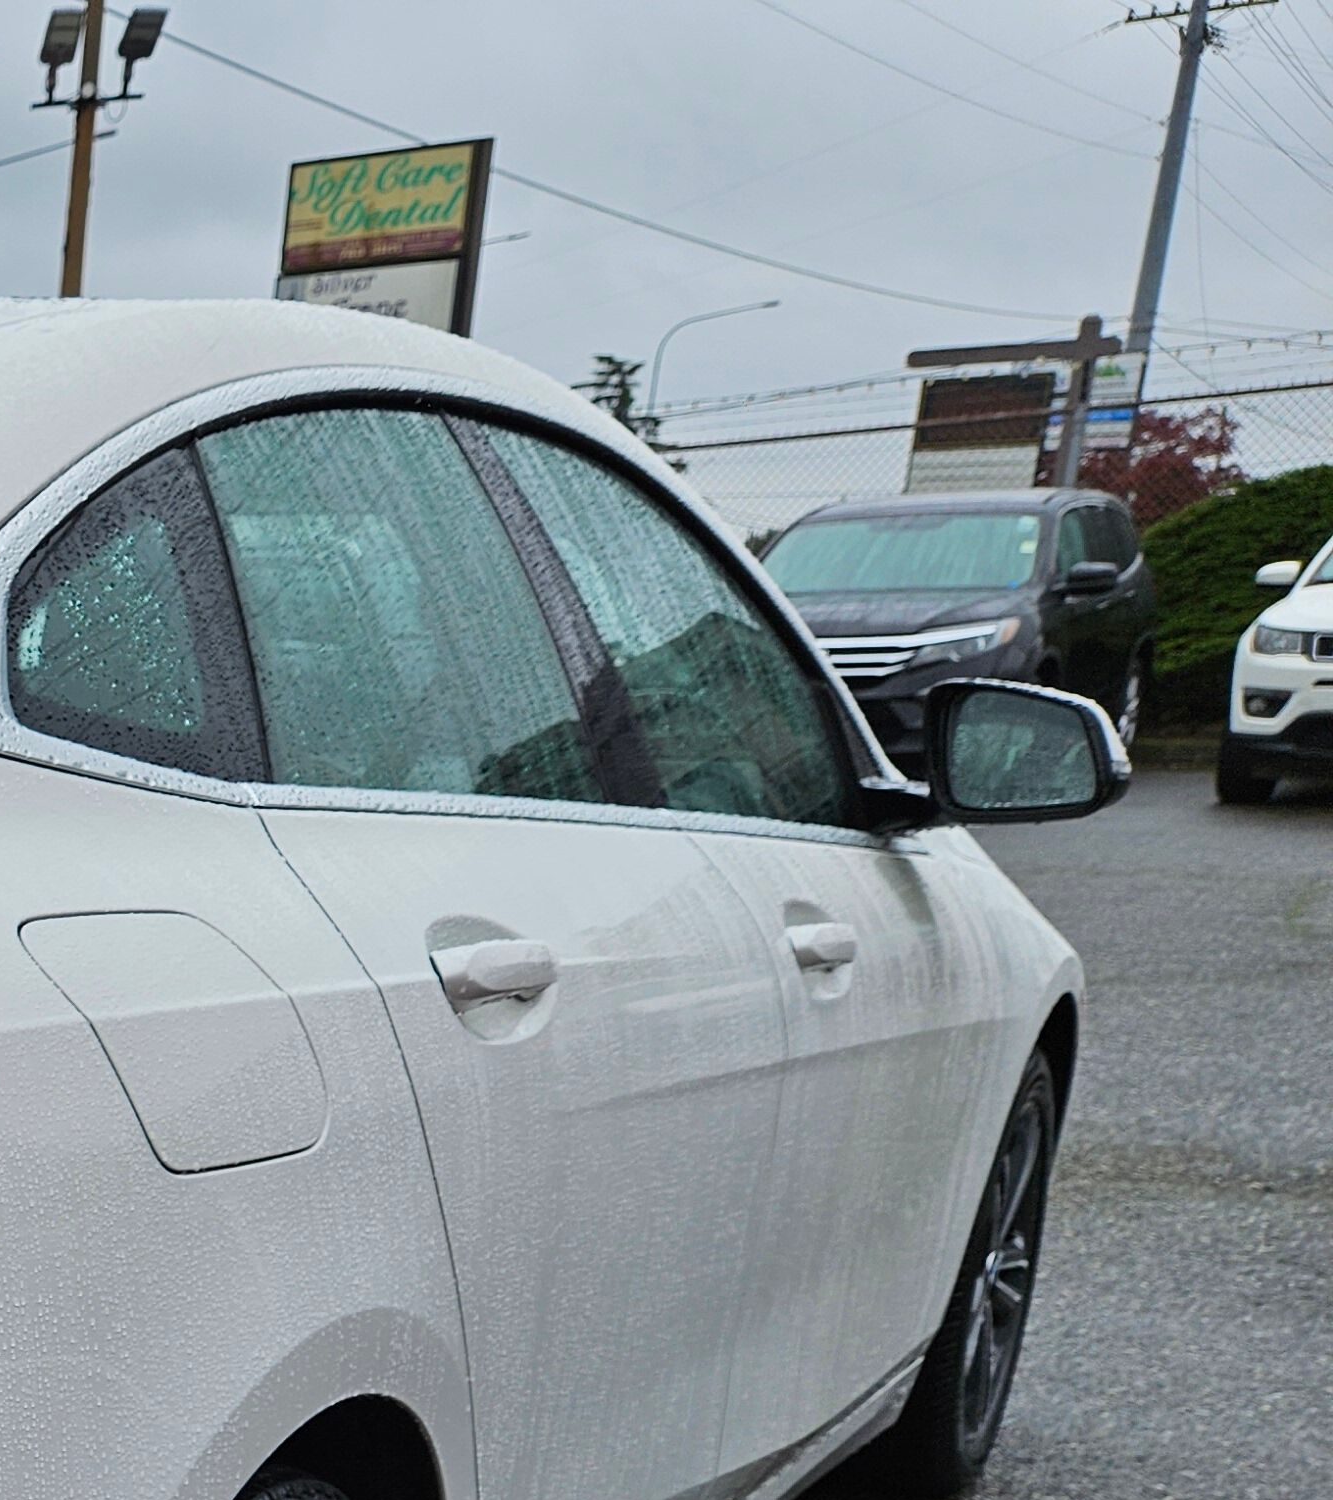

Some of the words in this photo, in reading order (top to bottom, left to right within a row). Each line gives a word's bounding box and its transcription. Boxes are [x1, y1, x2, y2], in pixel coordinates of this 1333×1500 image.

[290, 159, 368, 214] Soft
[376, 156, 465, 193] Care
[325, 185, 467, 236] Dental
